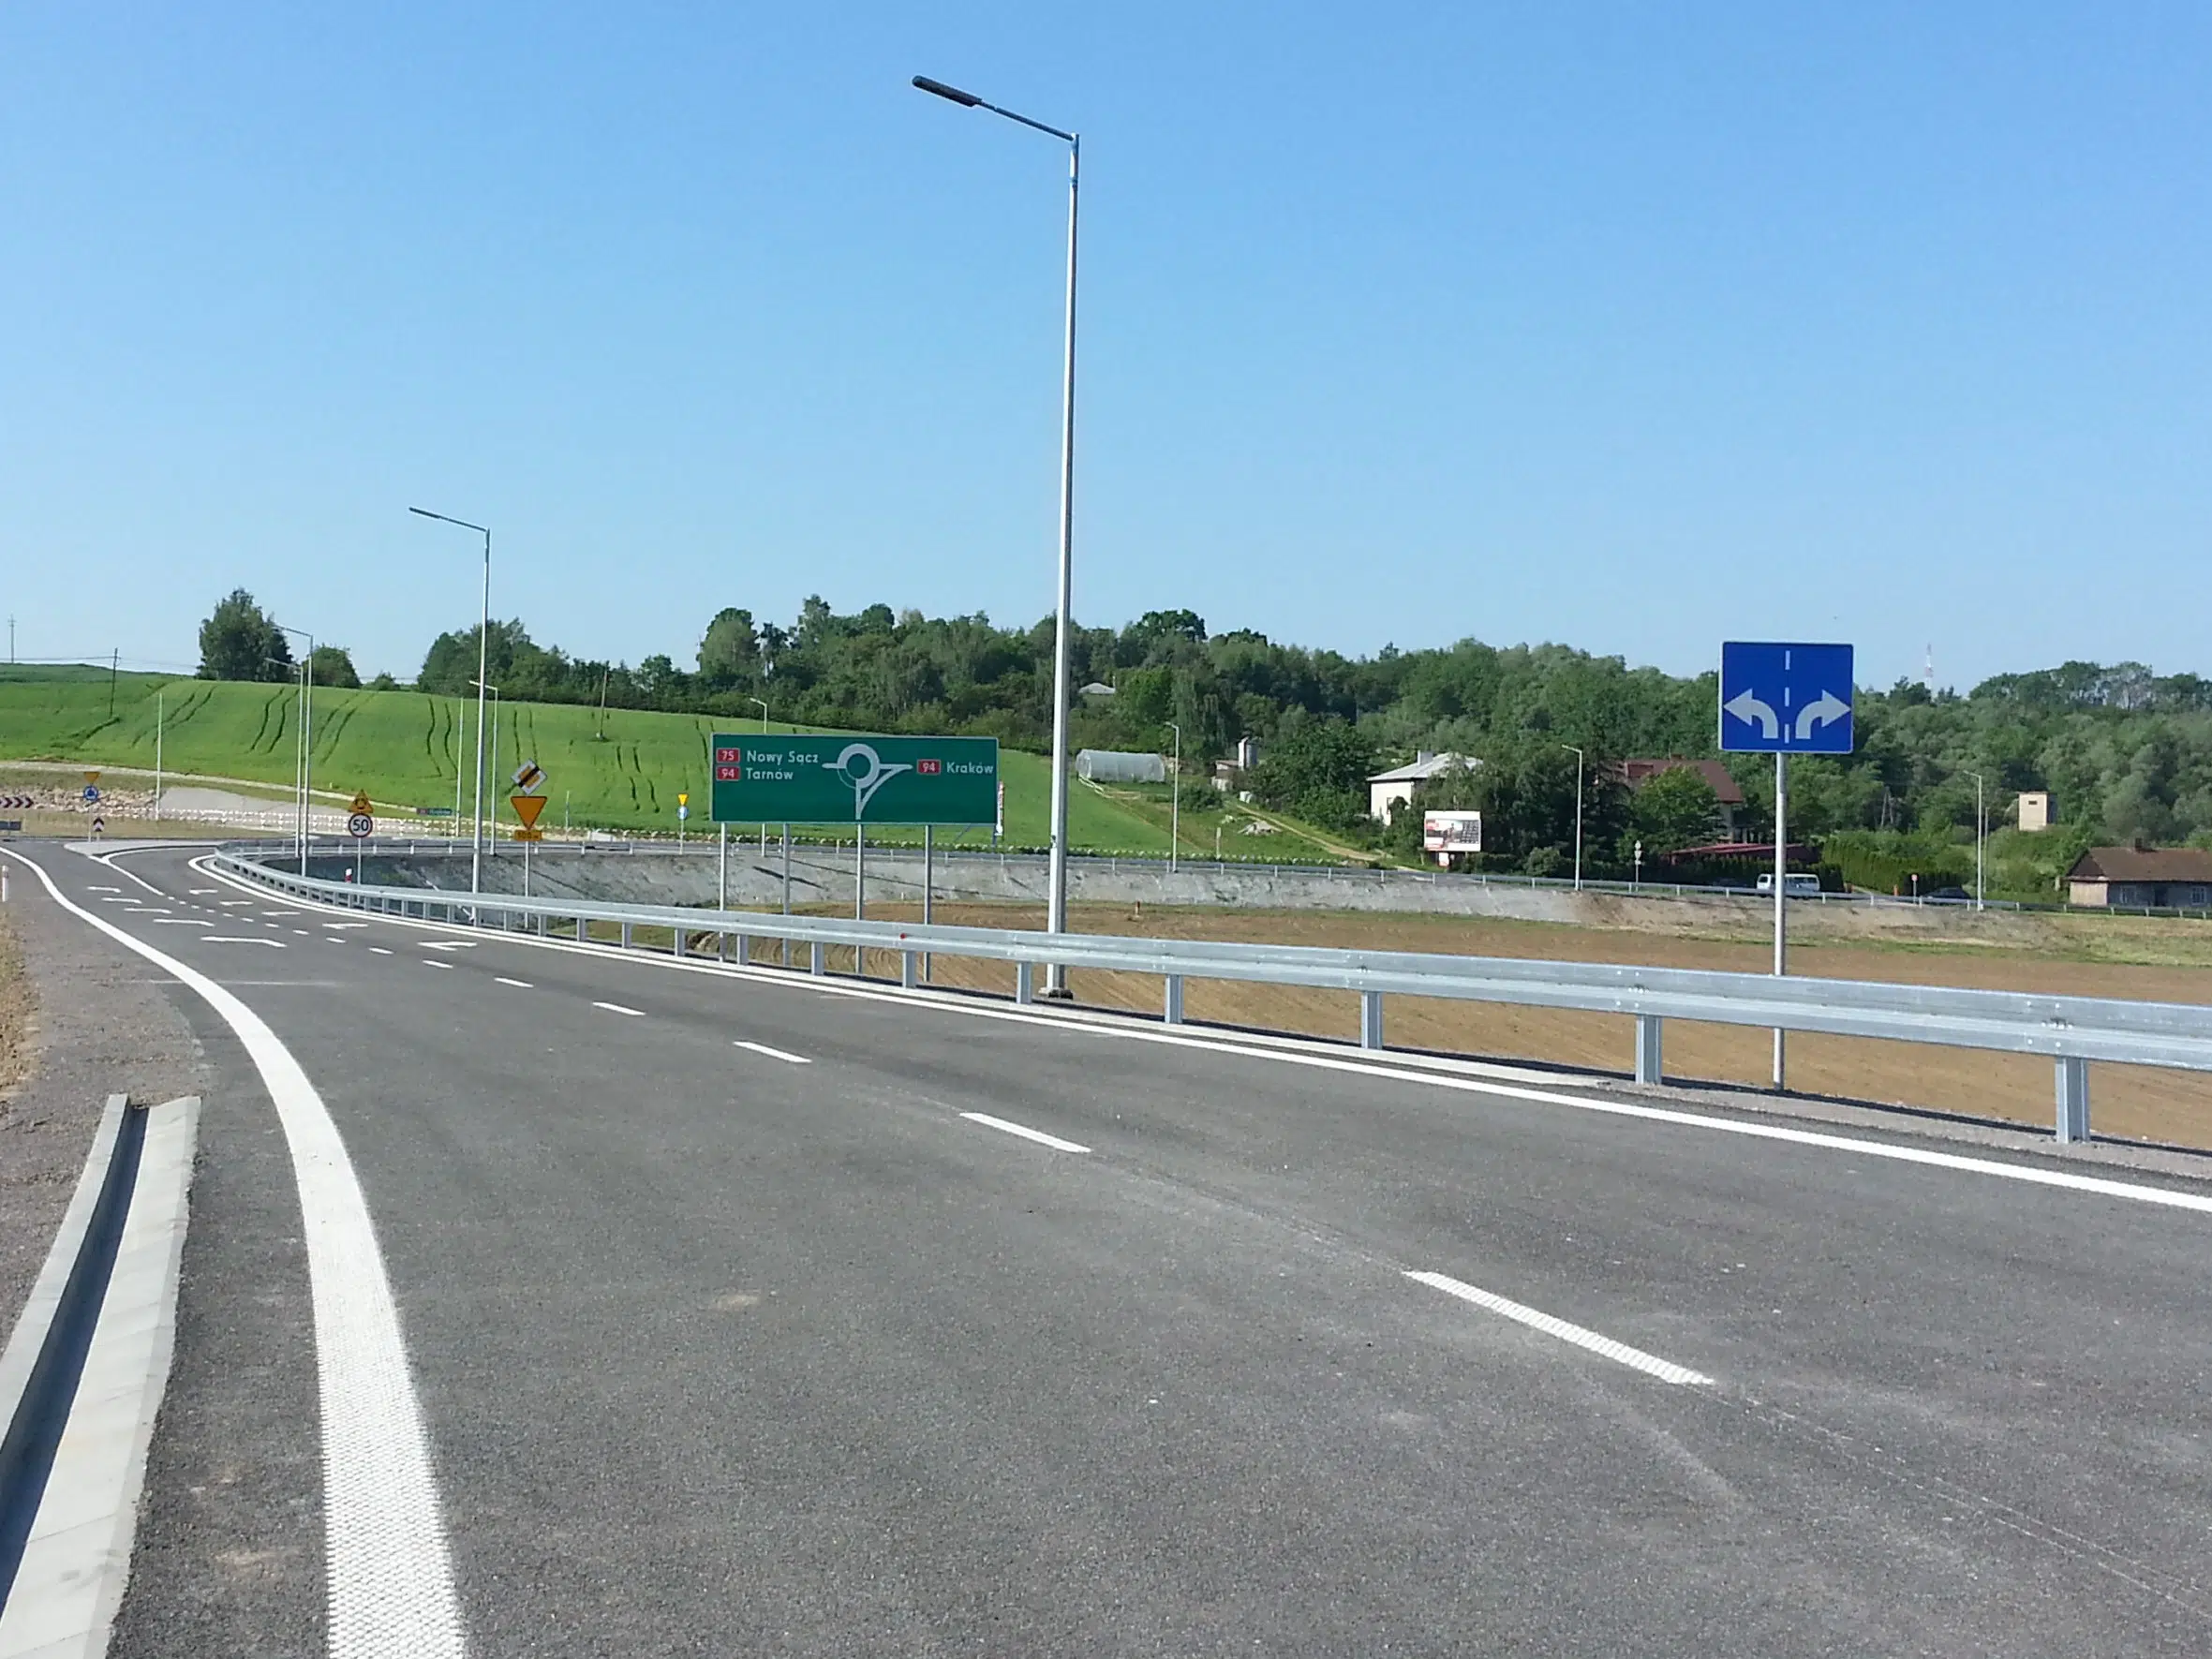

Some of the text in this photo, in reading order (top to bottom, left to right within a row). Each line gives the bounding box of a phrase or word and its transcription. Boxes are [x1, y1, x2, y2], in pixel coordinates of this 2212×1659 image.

[721, 750, 735, 762] 75
[747, 750, 819, 765] Nowy Sącz
[721, 768, 735, 779] 94
[746, 767, 794, 779] Tarnów
[922, 762, 936, 773] 94
[946, 762, 994, 774] Kraków
[352, 819, 369, 832] 50
